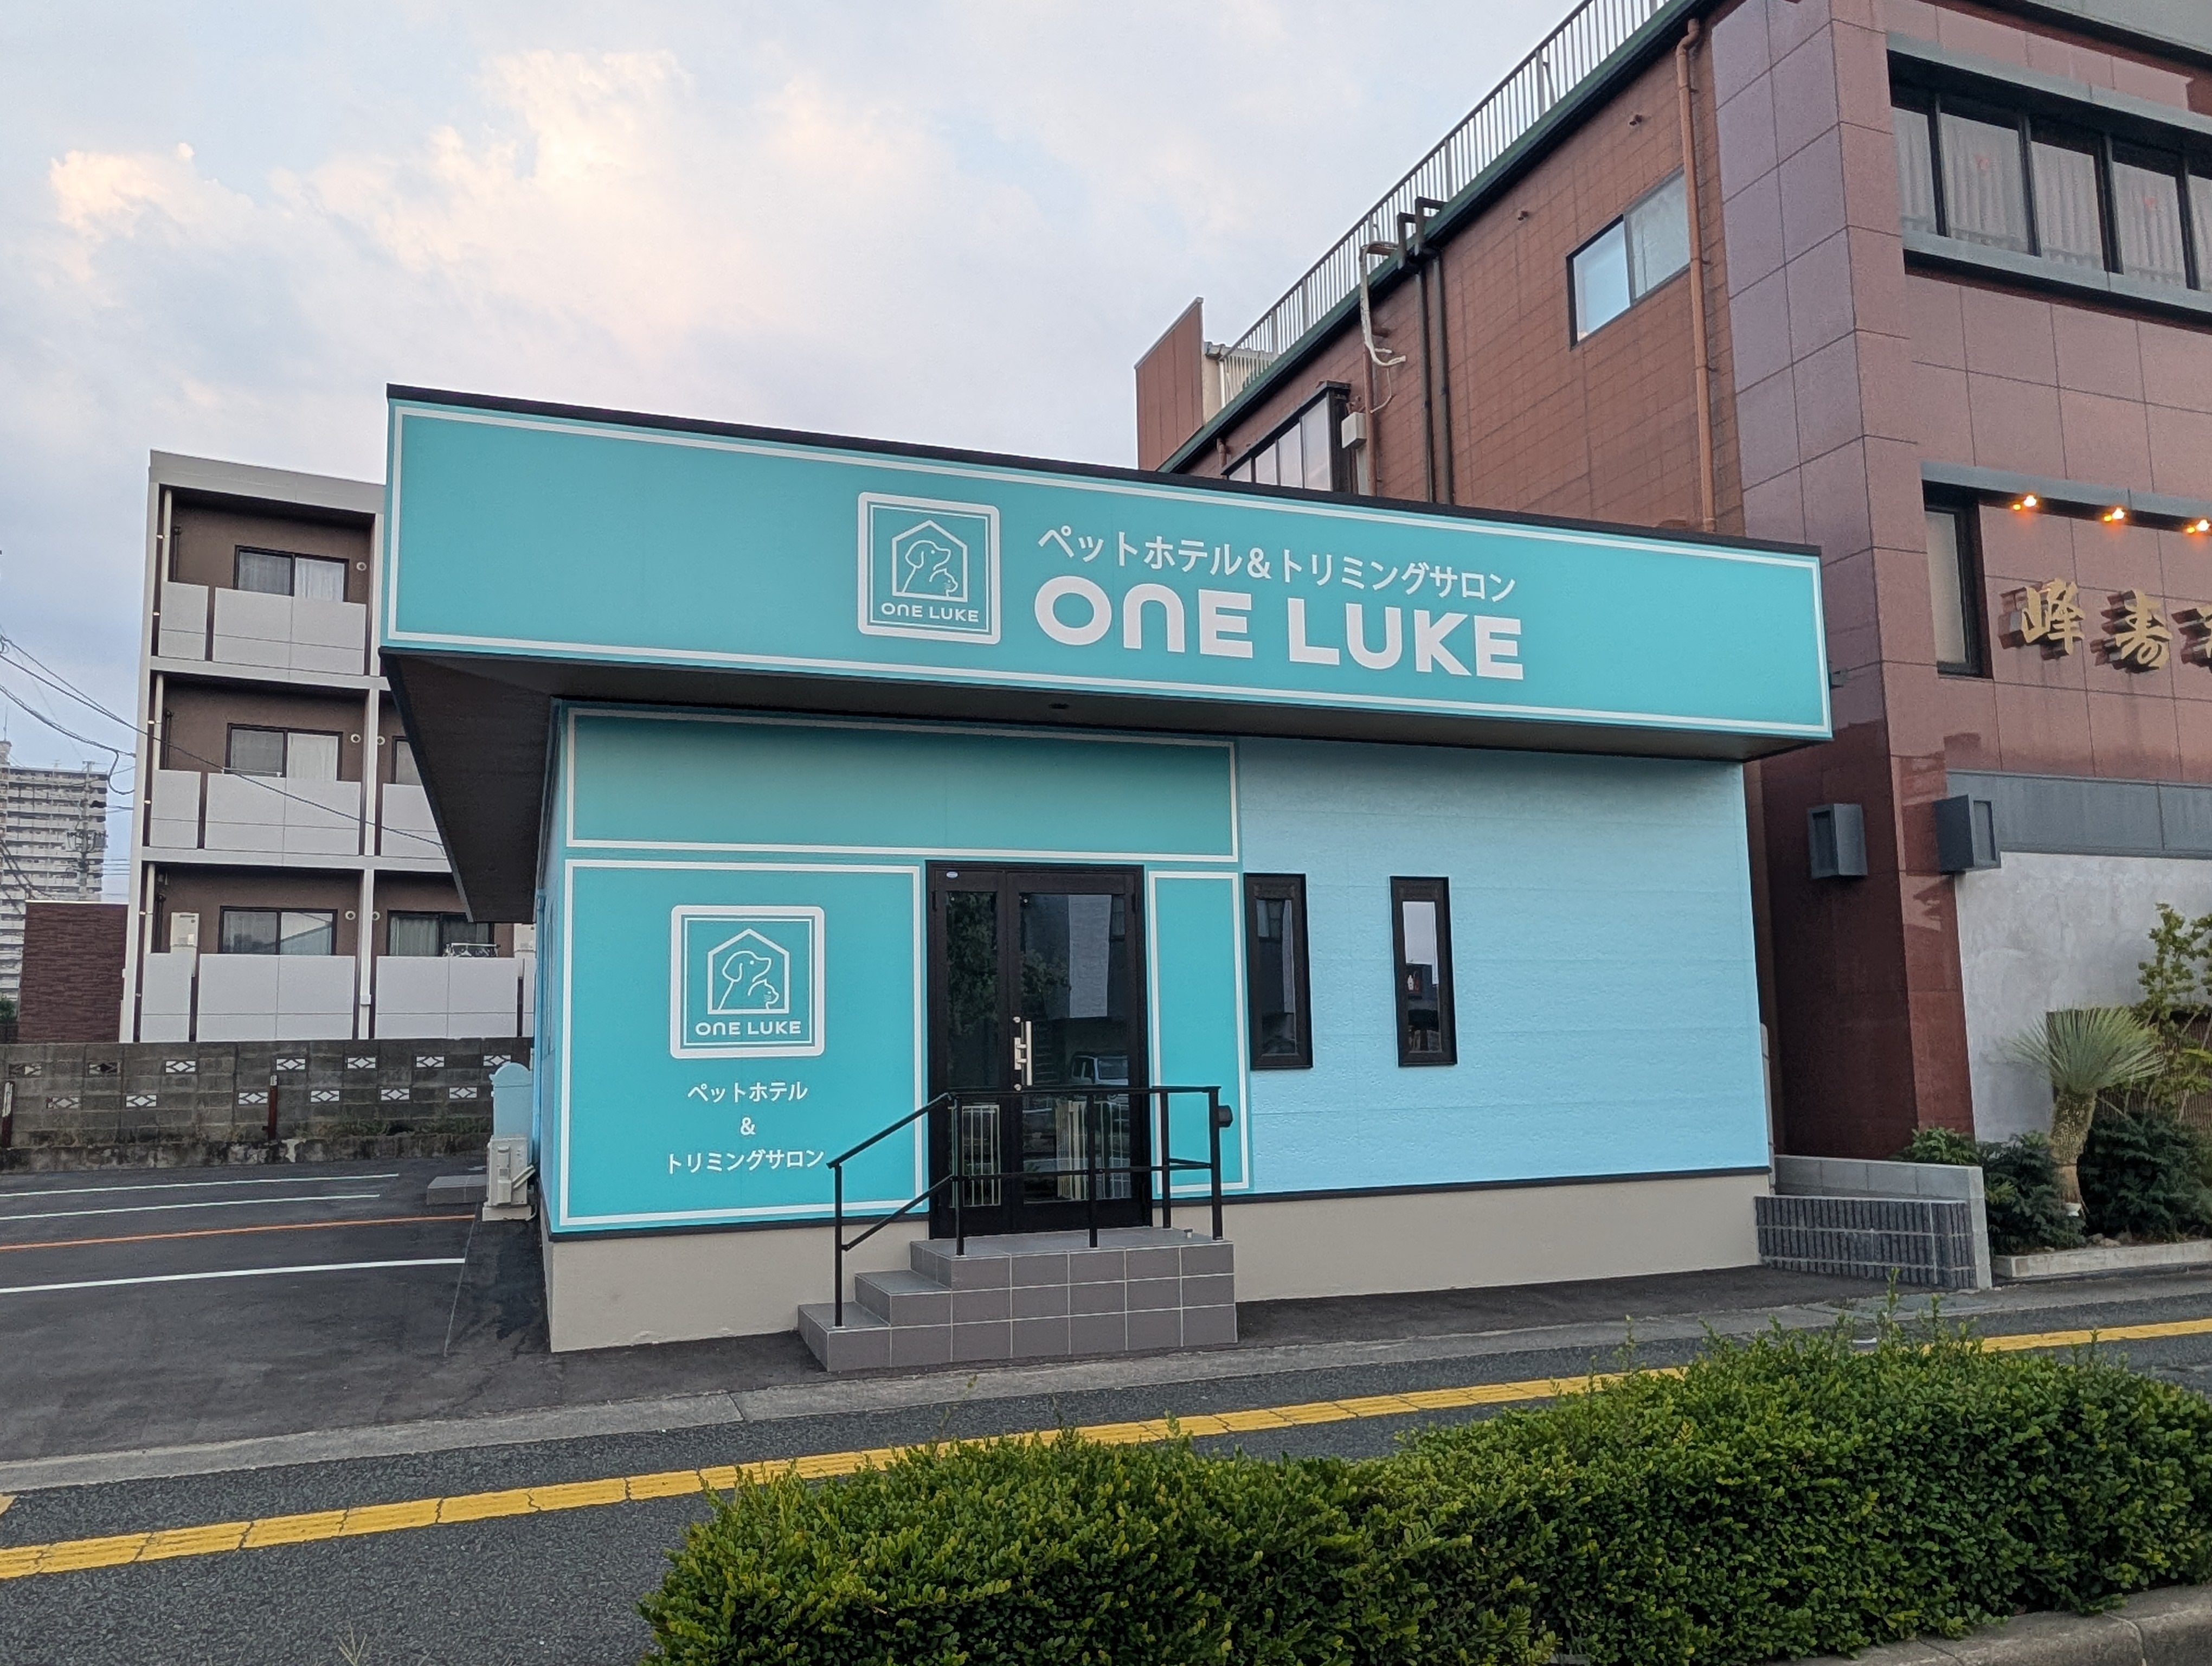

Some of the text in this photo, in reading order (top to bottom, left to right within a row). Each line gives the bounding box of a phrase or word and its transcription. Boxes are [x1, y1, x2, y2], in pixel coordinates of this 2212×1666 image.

[1038, 525, 1515, 603] ペットホテル&トリミングサロン
[881, 603, 979, 623] ONE LUKE
[2020, 577, 2212, 670] 峰寿
[1034, 575, 1523, 680] ONE LUKE
[695, 1021, 801, 1036] ONE LUKE
[687, 1081, 808, 1103] ペットホテル
[740, 1117, 756, 1136] &
[669, 1149, 824, 1174] トリミングサロン
